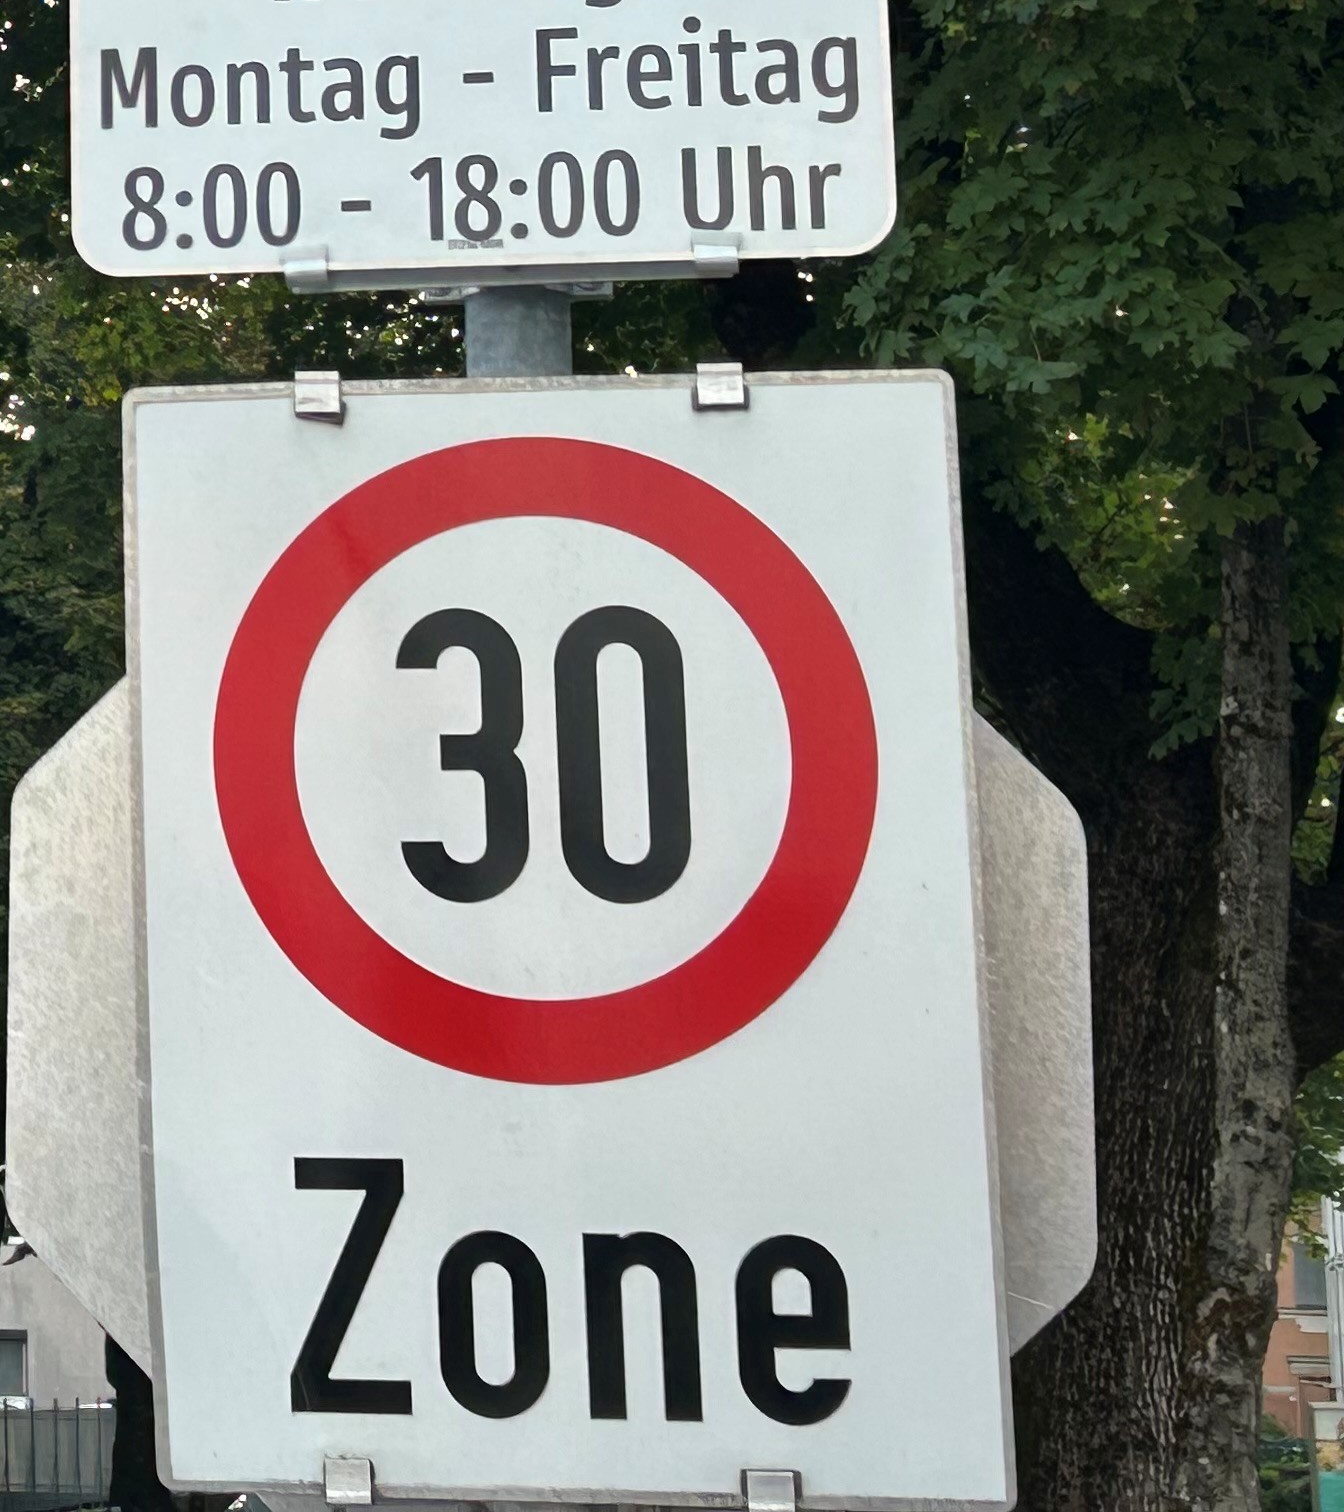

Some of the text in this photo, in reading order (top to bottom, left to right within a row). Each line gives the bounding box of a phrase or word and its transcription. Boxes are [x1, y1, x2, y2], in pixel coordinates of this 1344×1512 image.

[99, 15, 860, 141] Montag - Freitag
[121, 144, 843, 252] 8:00 - 18:00 Uhr
[394, 604, 693, 906] 30
[289, 1155, 853, 1428] Zone
